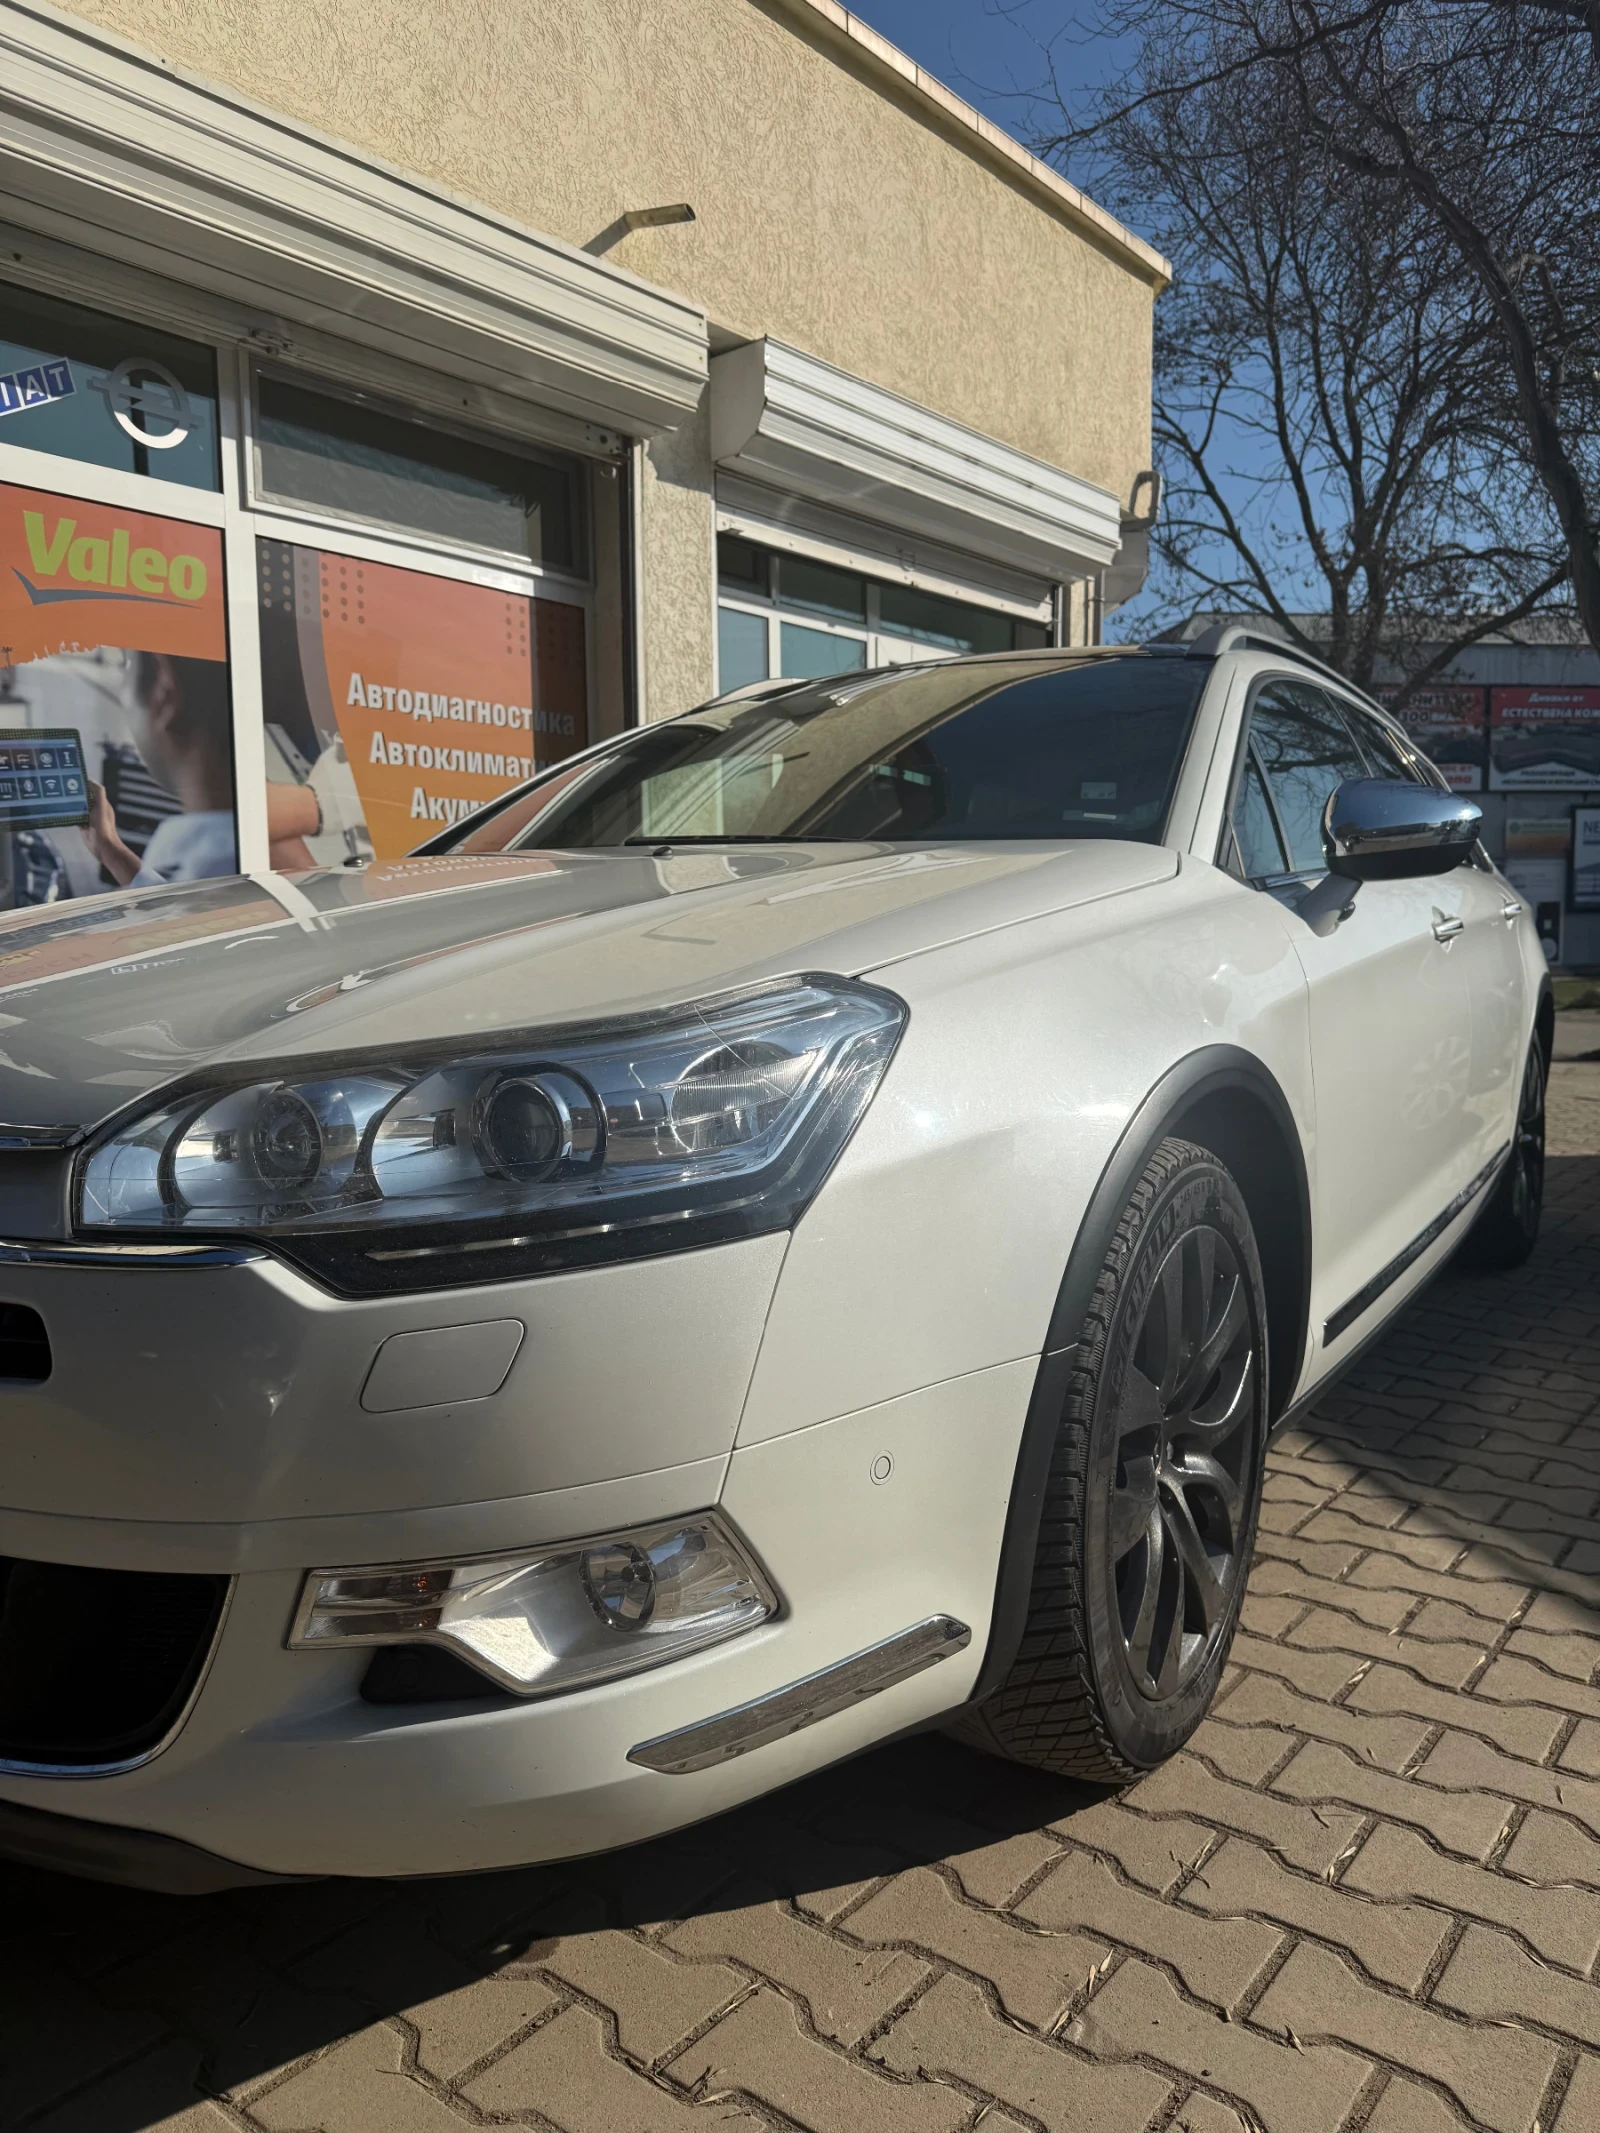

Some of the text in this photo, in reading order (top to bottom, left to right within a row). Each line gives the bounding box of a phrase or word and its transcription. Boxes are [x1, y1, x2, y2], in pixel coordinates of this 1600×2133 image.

[23, 510, 208, 601] Valeo
[347, 672, 576, 736] Автодиагностика
[369, 731, 552, 779] Автоклимати
[410, 786, 487, 828] Акум
